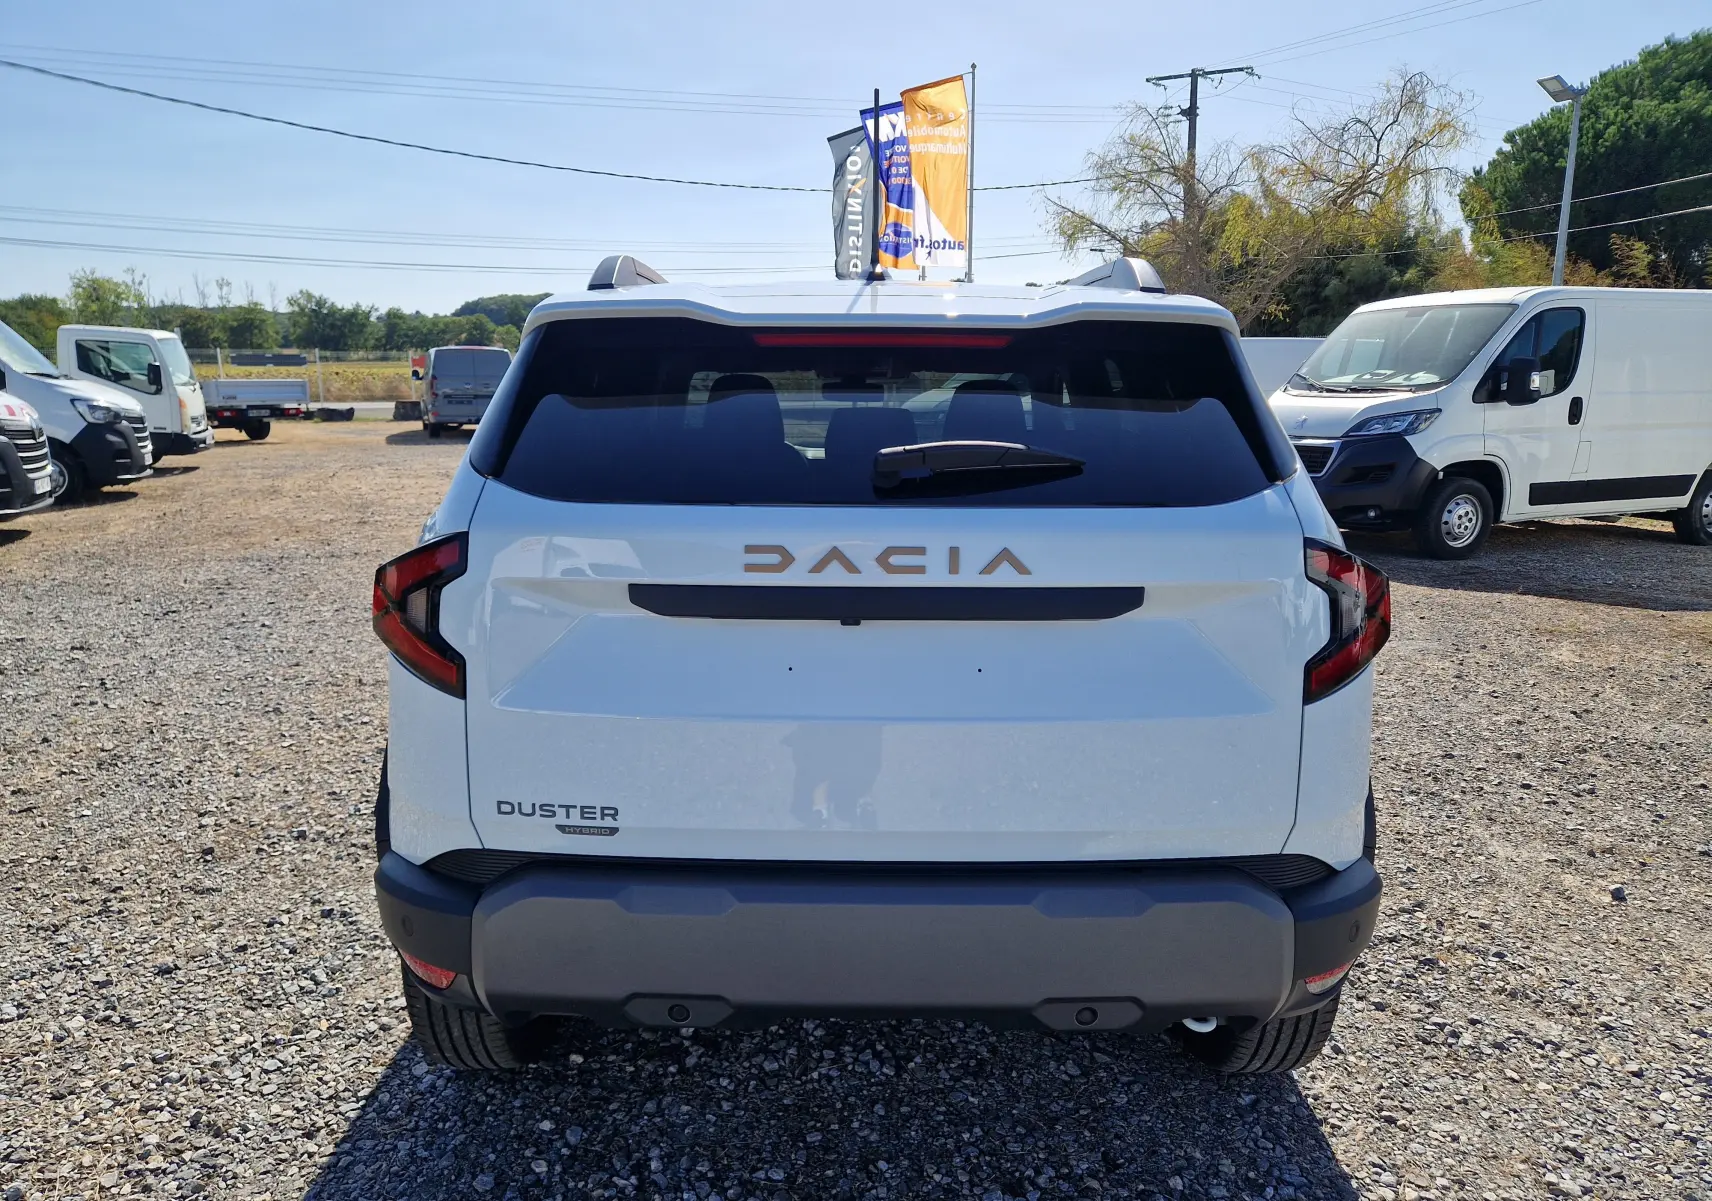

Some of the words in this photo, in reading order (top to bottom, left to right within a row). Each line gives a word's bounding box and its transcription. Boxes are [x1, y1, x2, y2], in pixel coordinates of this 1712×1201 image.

[744, 545, 1032, 575] DACIA
[496, 800, 619, 821] DUSTER
[565, 827, 610, 835] HYBRID
